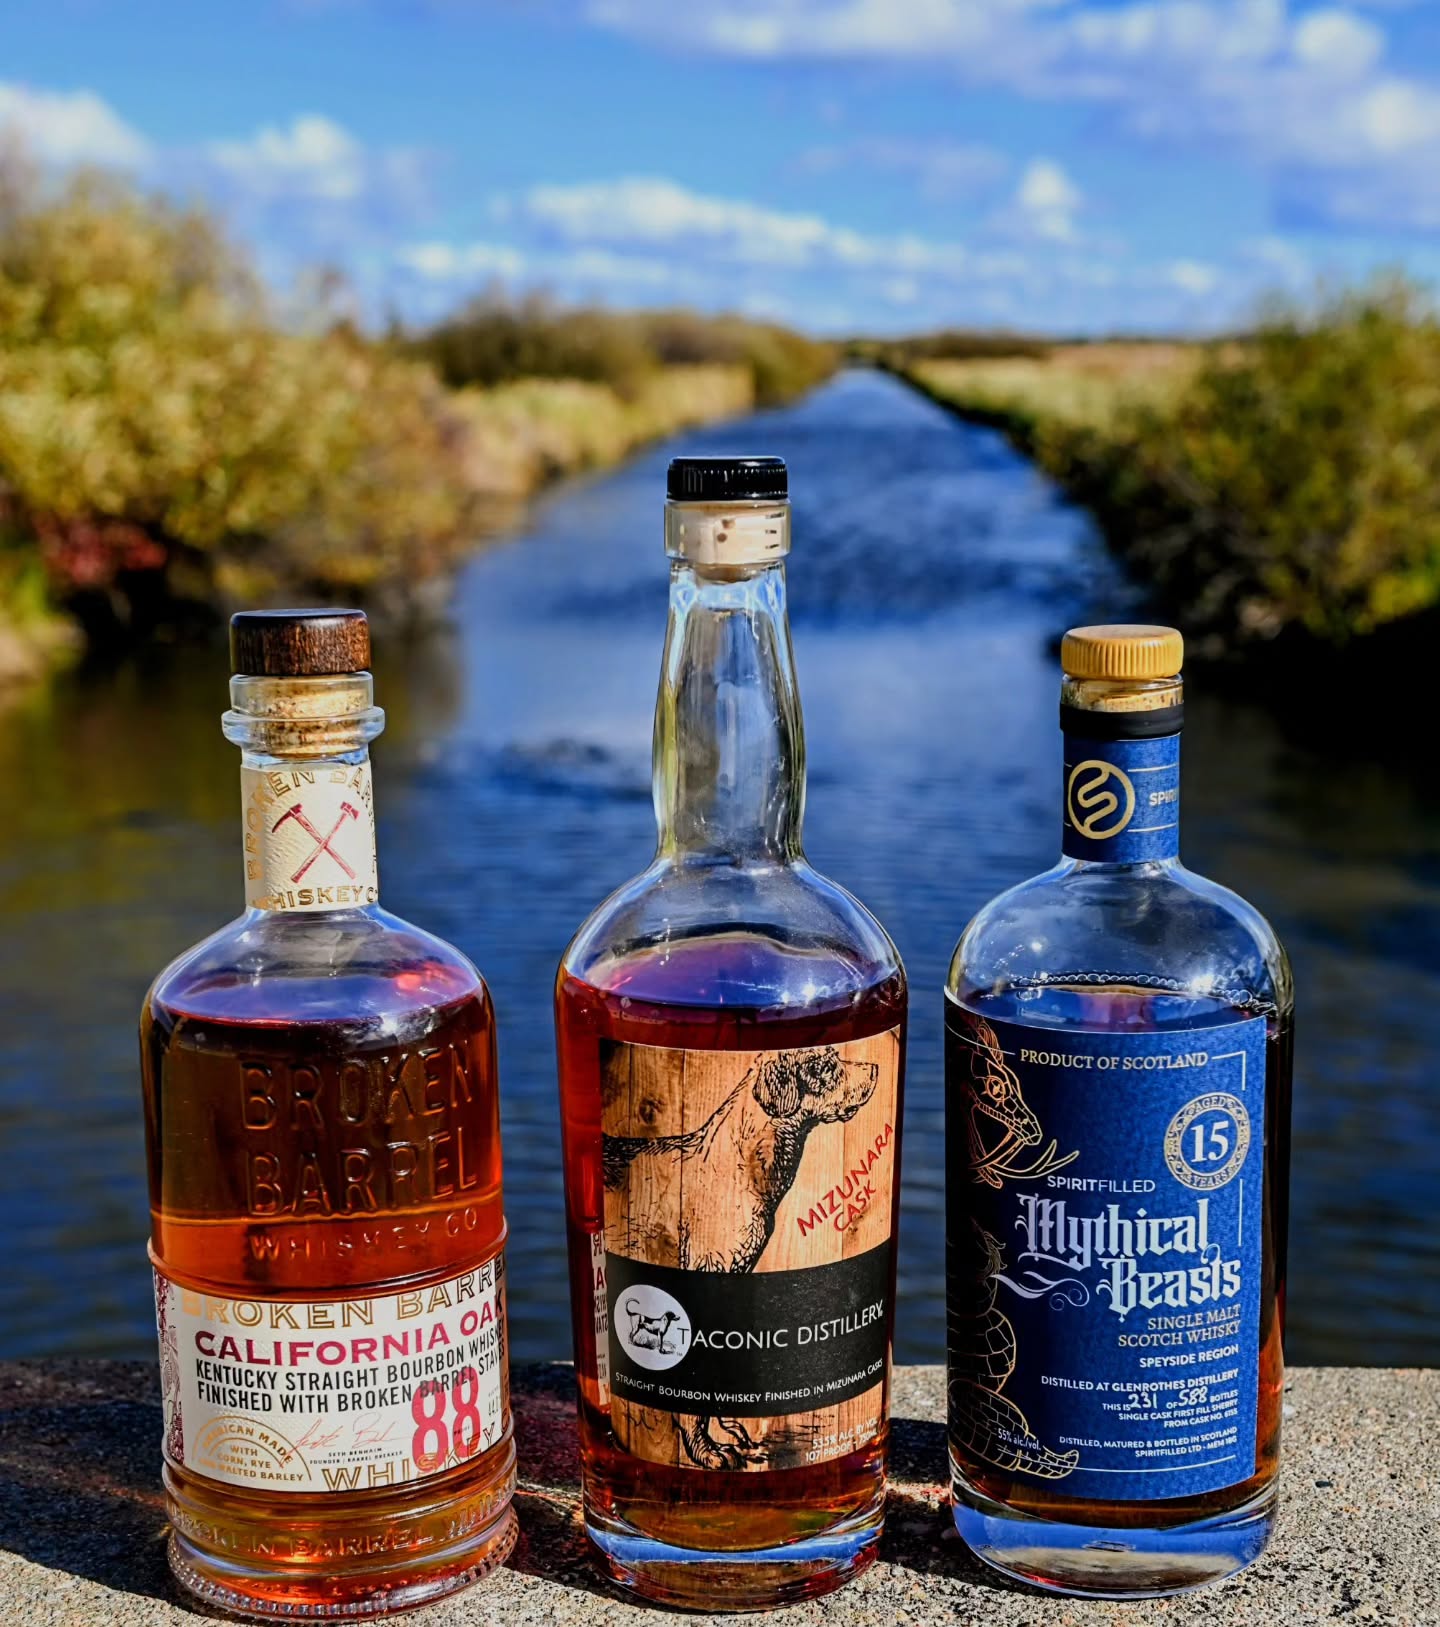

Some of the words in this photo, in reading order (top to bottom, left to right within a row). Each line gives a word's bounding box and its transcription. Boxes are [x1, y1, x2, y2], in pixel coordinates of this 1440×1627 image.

[1020, 1049, 1094, 1069] PRODUCT
[1097, 1056, 1118, 1069] OF
[1122, 1052, 1209, 1070] SCOTLAND
[239, 1040, 473, 1130] BROKEN
[1193, 1096, 1226, 1113] AGED
[1190, 1120, 1229, 1163] 15
[247, 1127, 478, 1216] BARREL
[796, 1122, 894, 1237] MIZUNARA
[1047, 1175, 1156, 1193] SPIRITFILLED
[1191, 1171, 1229, 1187] YEARS
[833, 1179, 877, 1233] CASK
[1014, 1192, 1210, 1271] Mythical
[1096, 1243, 1242, 1322] Beasts
[194, 1322, 451, 1367] CALIFORNIA
[460, 1287, 503, 1337] OAK
[1147, 1312, 1203, 1330] SINGLE
[1206, 1303, 1241, 1324] MALT
[677, 1327, 788, 1349] TACONIC
[1118, 1332, 1183, 1347] SCOTCH
[1186, 1320, 1241, 1343] WHISKY
[196, 1358, 277, 1390] KENTUCKY
[285, 1368, 379, 1391] STRAIGHT
[388, 1345, 464, 1383] BOURBON
[1140, 1353, 1197, 1368] SPEYSIDE
[1198, 1344, 1239, 1362] REGION
[197, 1381, 272, 1412] FINISHED
[279, 1394, 329, 1413] WITH
[338, 1383, 412, 1412] BROKEN
[420, 1364, 475, 1397] BARREL
[615, 1372, 656, 1391] STRAIGHT
[658, 1385, 711, 1401] BOURBON
[714, 1392, 762, 1403] WHISKEY
[765, 1388, 810, 1402] FINISHED
[813, 1385, 824, 1395] IN
[826, 1370, 866, 1392] MIZUNARA
[1041, 1375, 1094, 1390] DISTILLED
[1095, 1382, 1110, 1391] AT
[1111, 1380, 1186, 1393] GLENROTHES
[1187, 1368, 1239, 1388] DISTILLERY
[1102, 1402, 1121, 1411] THIS
[1128, 1391, 1158, 1409] 231
[1166, 1402, 1178, 1410] OF
[1178, 1386, 1208, 1407] 588
[1209, 1389, 1239, 1403] BOTTLES
[1118, 1412, 1149, 1420] SINGLE
[1150, 1411, 1173, 1420] CASK
[1173, 1408, 1196, 1418] FIRST
[1196, 1406, 1212, 1415] FILL
[1211, 1398, 1239, 1412] SHERRY
[411, 1366, 481, 1472] 88
[1164, 1419, 1189, 1428] FROM
[1189, 1415, 1212, 1425] CASK
[998, 1427, 1012, 1442] 55%
[1103, 1439, 1145, 1448] MATURED
[1154, 1437, 1189, 1448] BOTTLED
[1190, 1435, 1200, 1444] IN
[1200, 1426, 1238, 1442] SCOTLAND
[230, 1445, 258, 1456] WITH
[258, 1432, 293, 1464] MADE
[805, 1450, 821, 1462] 107
[823, 1441, 852, 1457] PROOF
[1135, 1446, 1187, 1458] SPIRITFILLED
[251, 1460, 271, 1469] RYE
[260, 1470, 304, 1482] BARLEY
